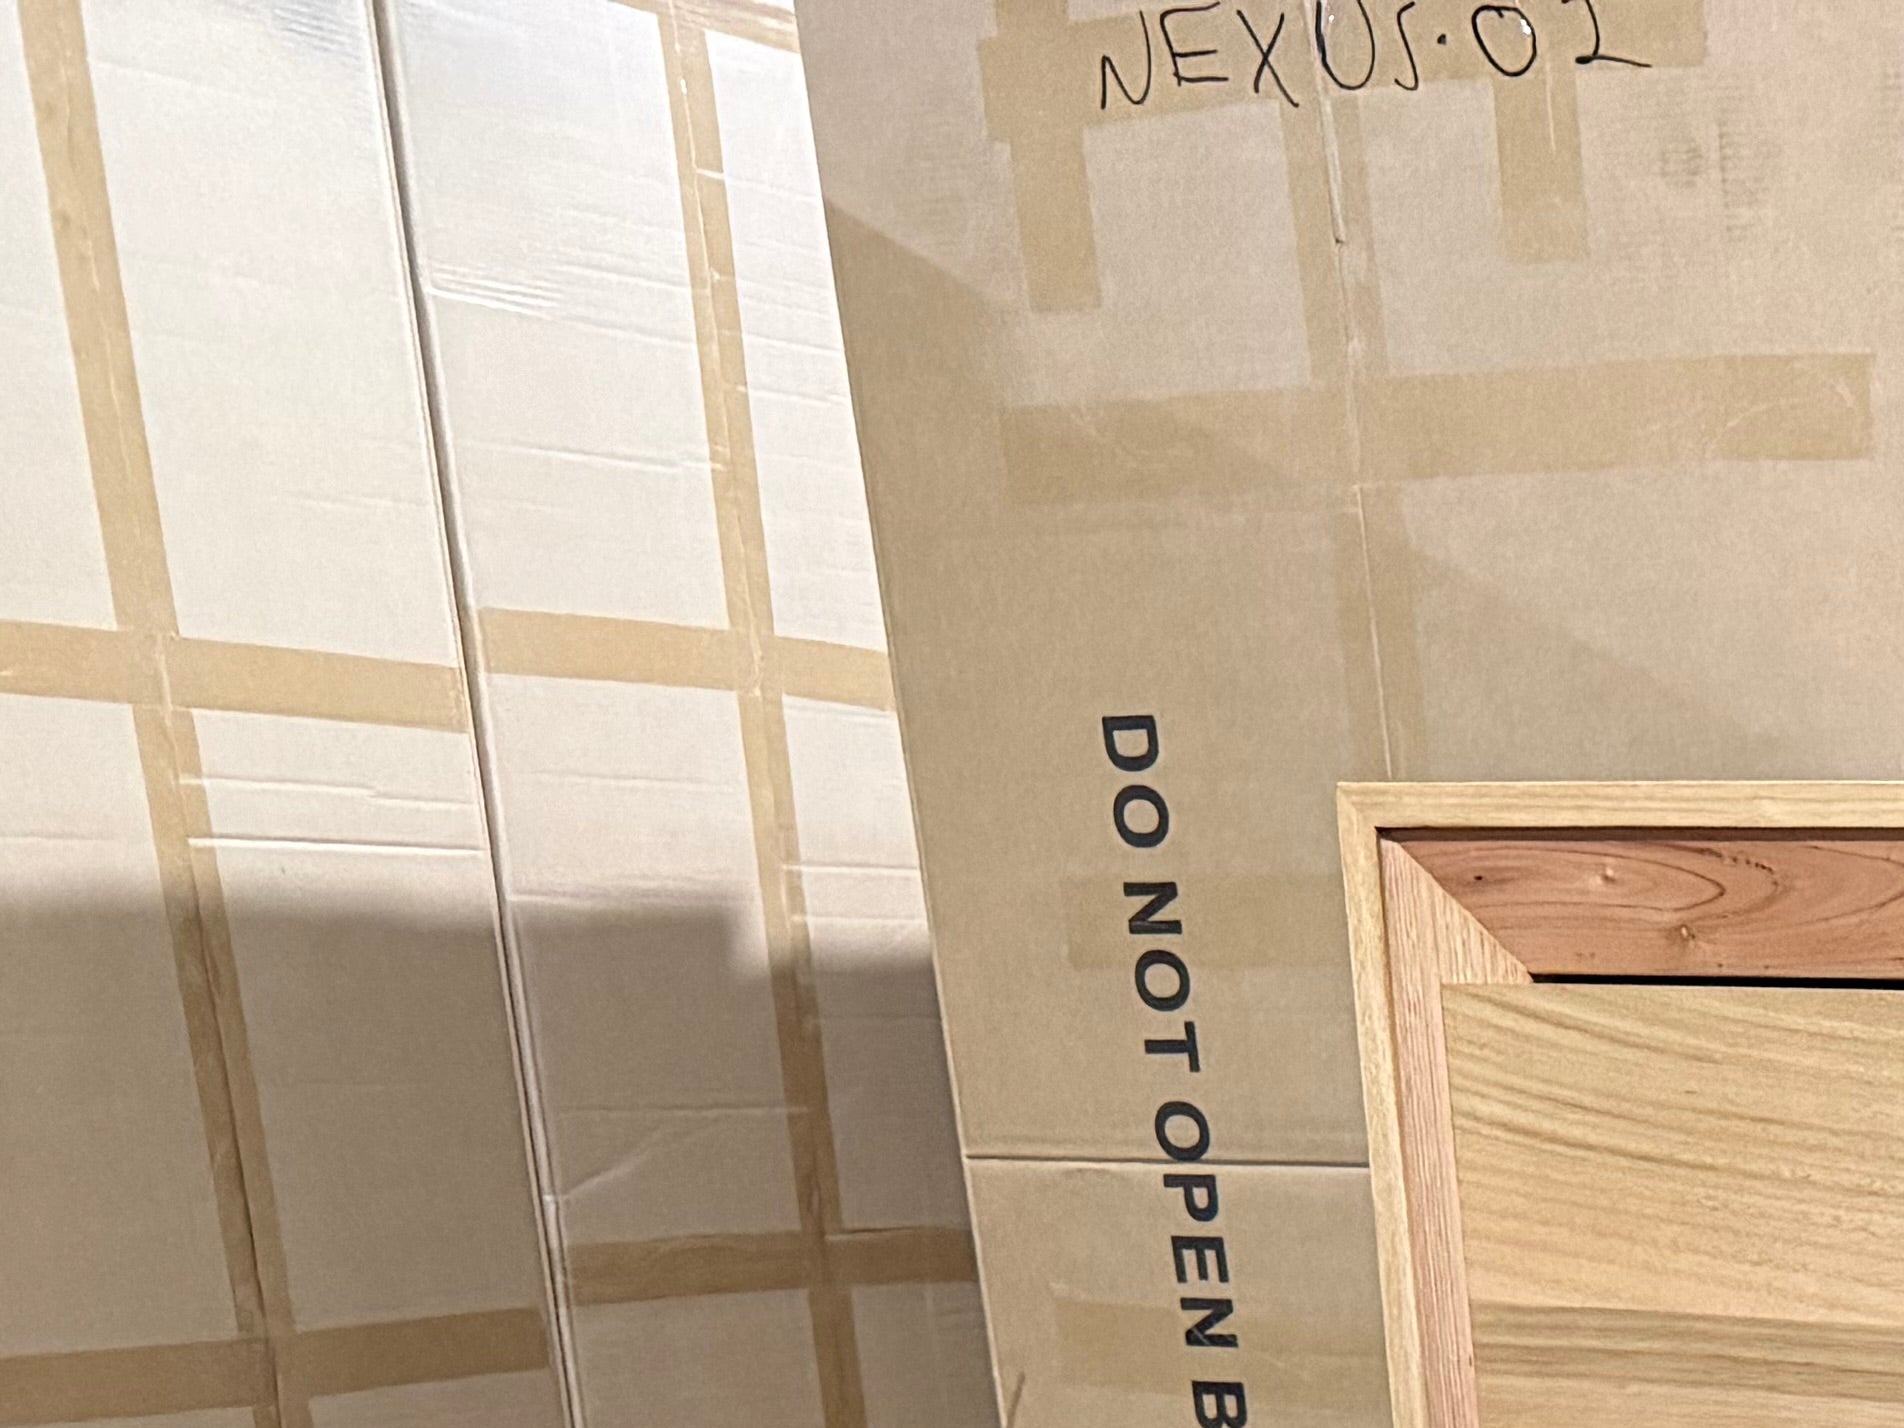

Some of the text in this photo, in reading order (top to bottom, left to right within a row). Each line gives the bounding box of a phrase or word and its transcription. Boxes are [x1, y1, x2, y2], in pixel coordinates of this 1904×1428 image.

[1102, 714, 1170, 848] DO
[1122, 881, 1201, 1073] NOT
[1154, 1100, 1239, 1348] OPEN
